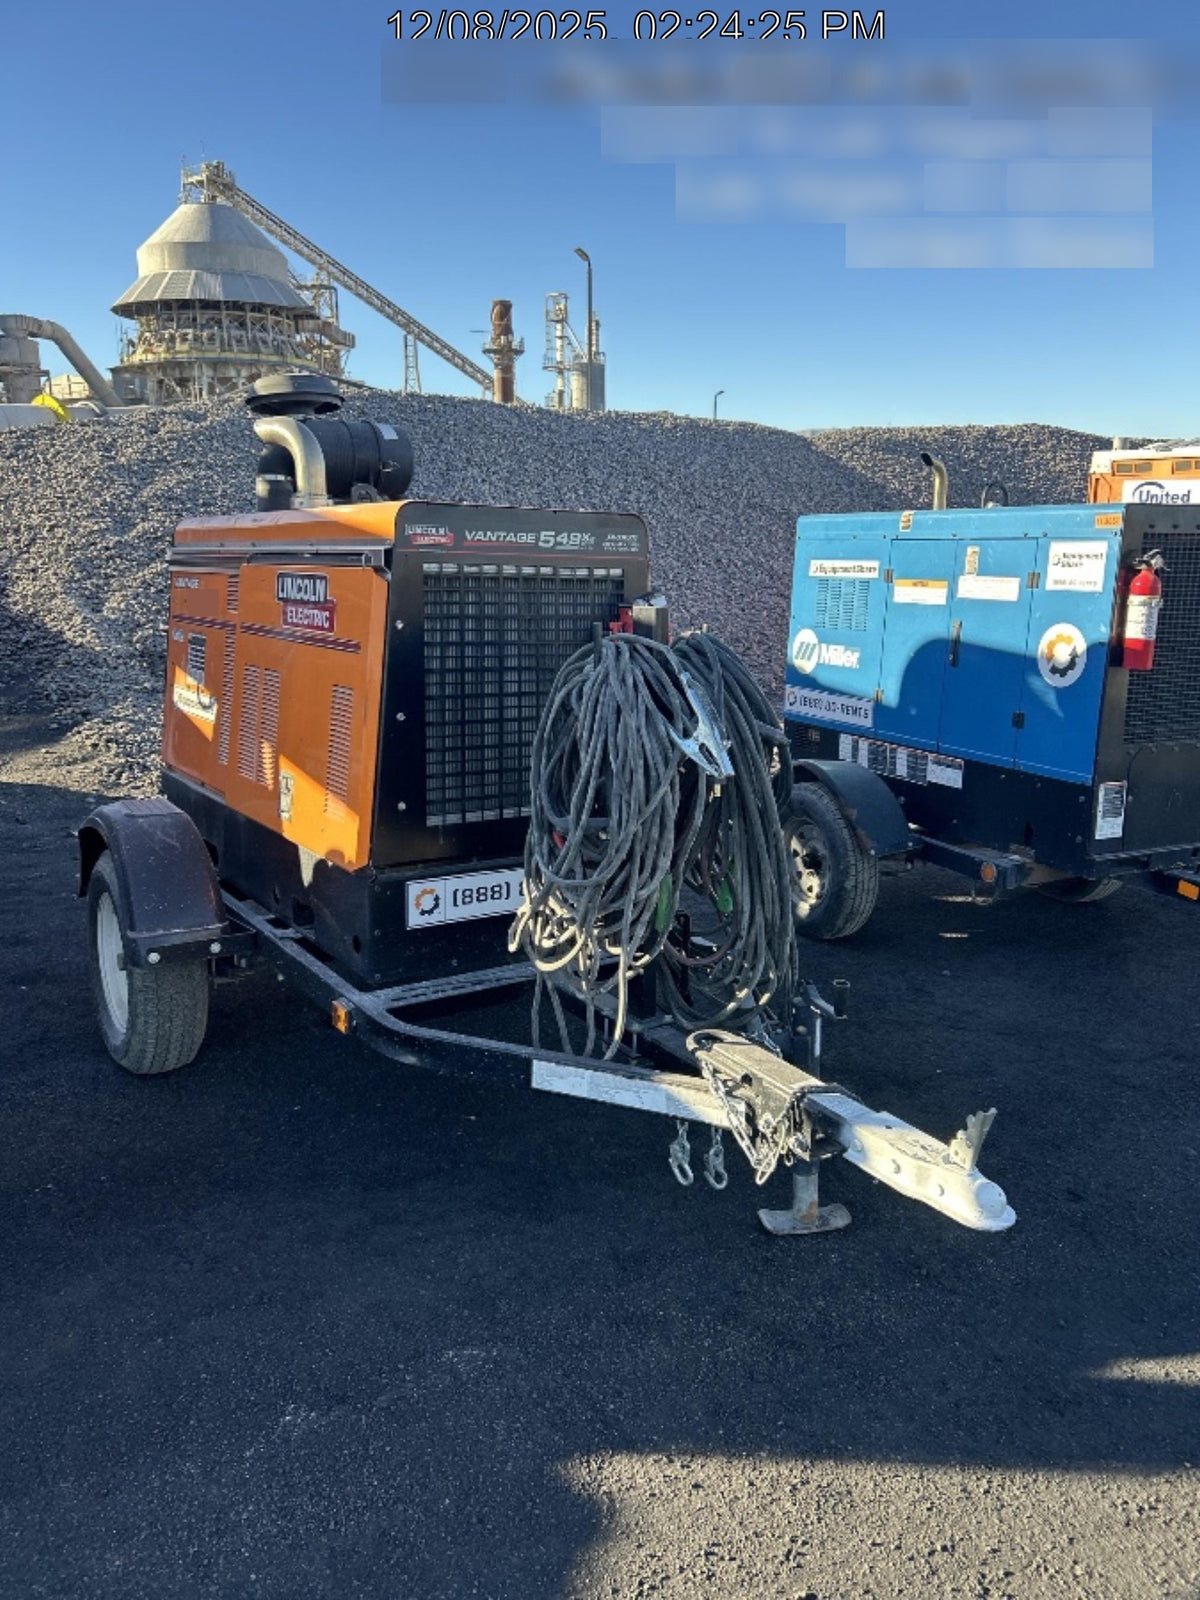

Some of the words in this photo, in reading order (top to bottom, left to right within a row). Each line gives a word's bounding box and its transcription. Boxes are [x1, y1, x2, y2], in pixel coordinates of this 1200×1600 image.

[1139, 488, 1191, 504] United
[464, 529, 536, 543] VANTAGE
[278, 576, 327, 602] LINCOLN
[287, 606, 330, 628] ELECTRIC
[819, 643, 860, 669] Miller
[452, 881, 511, 908] (888)
